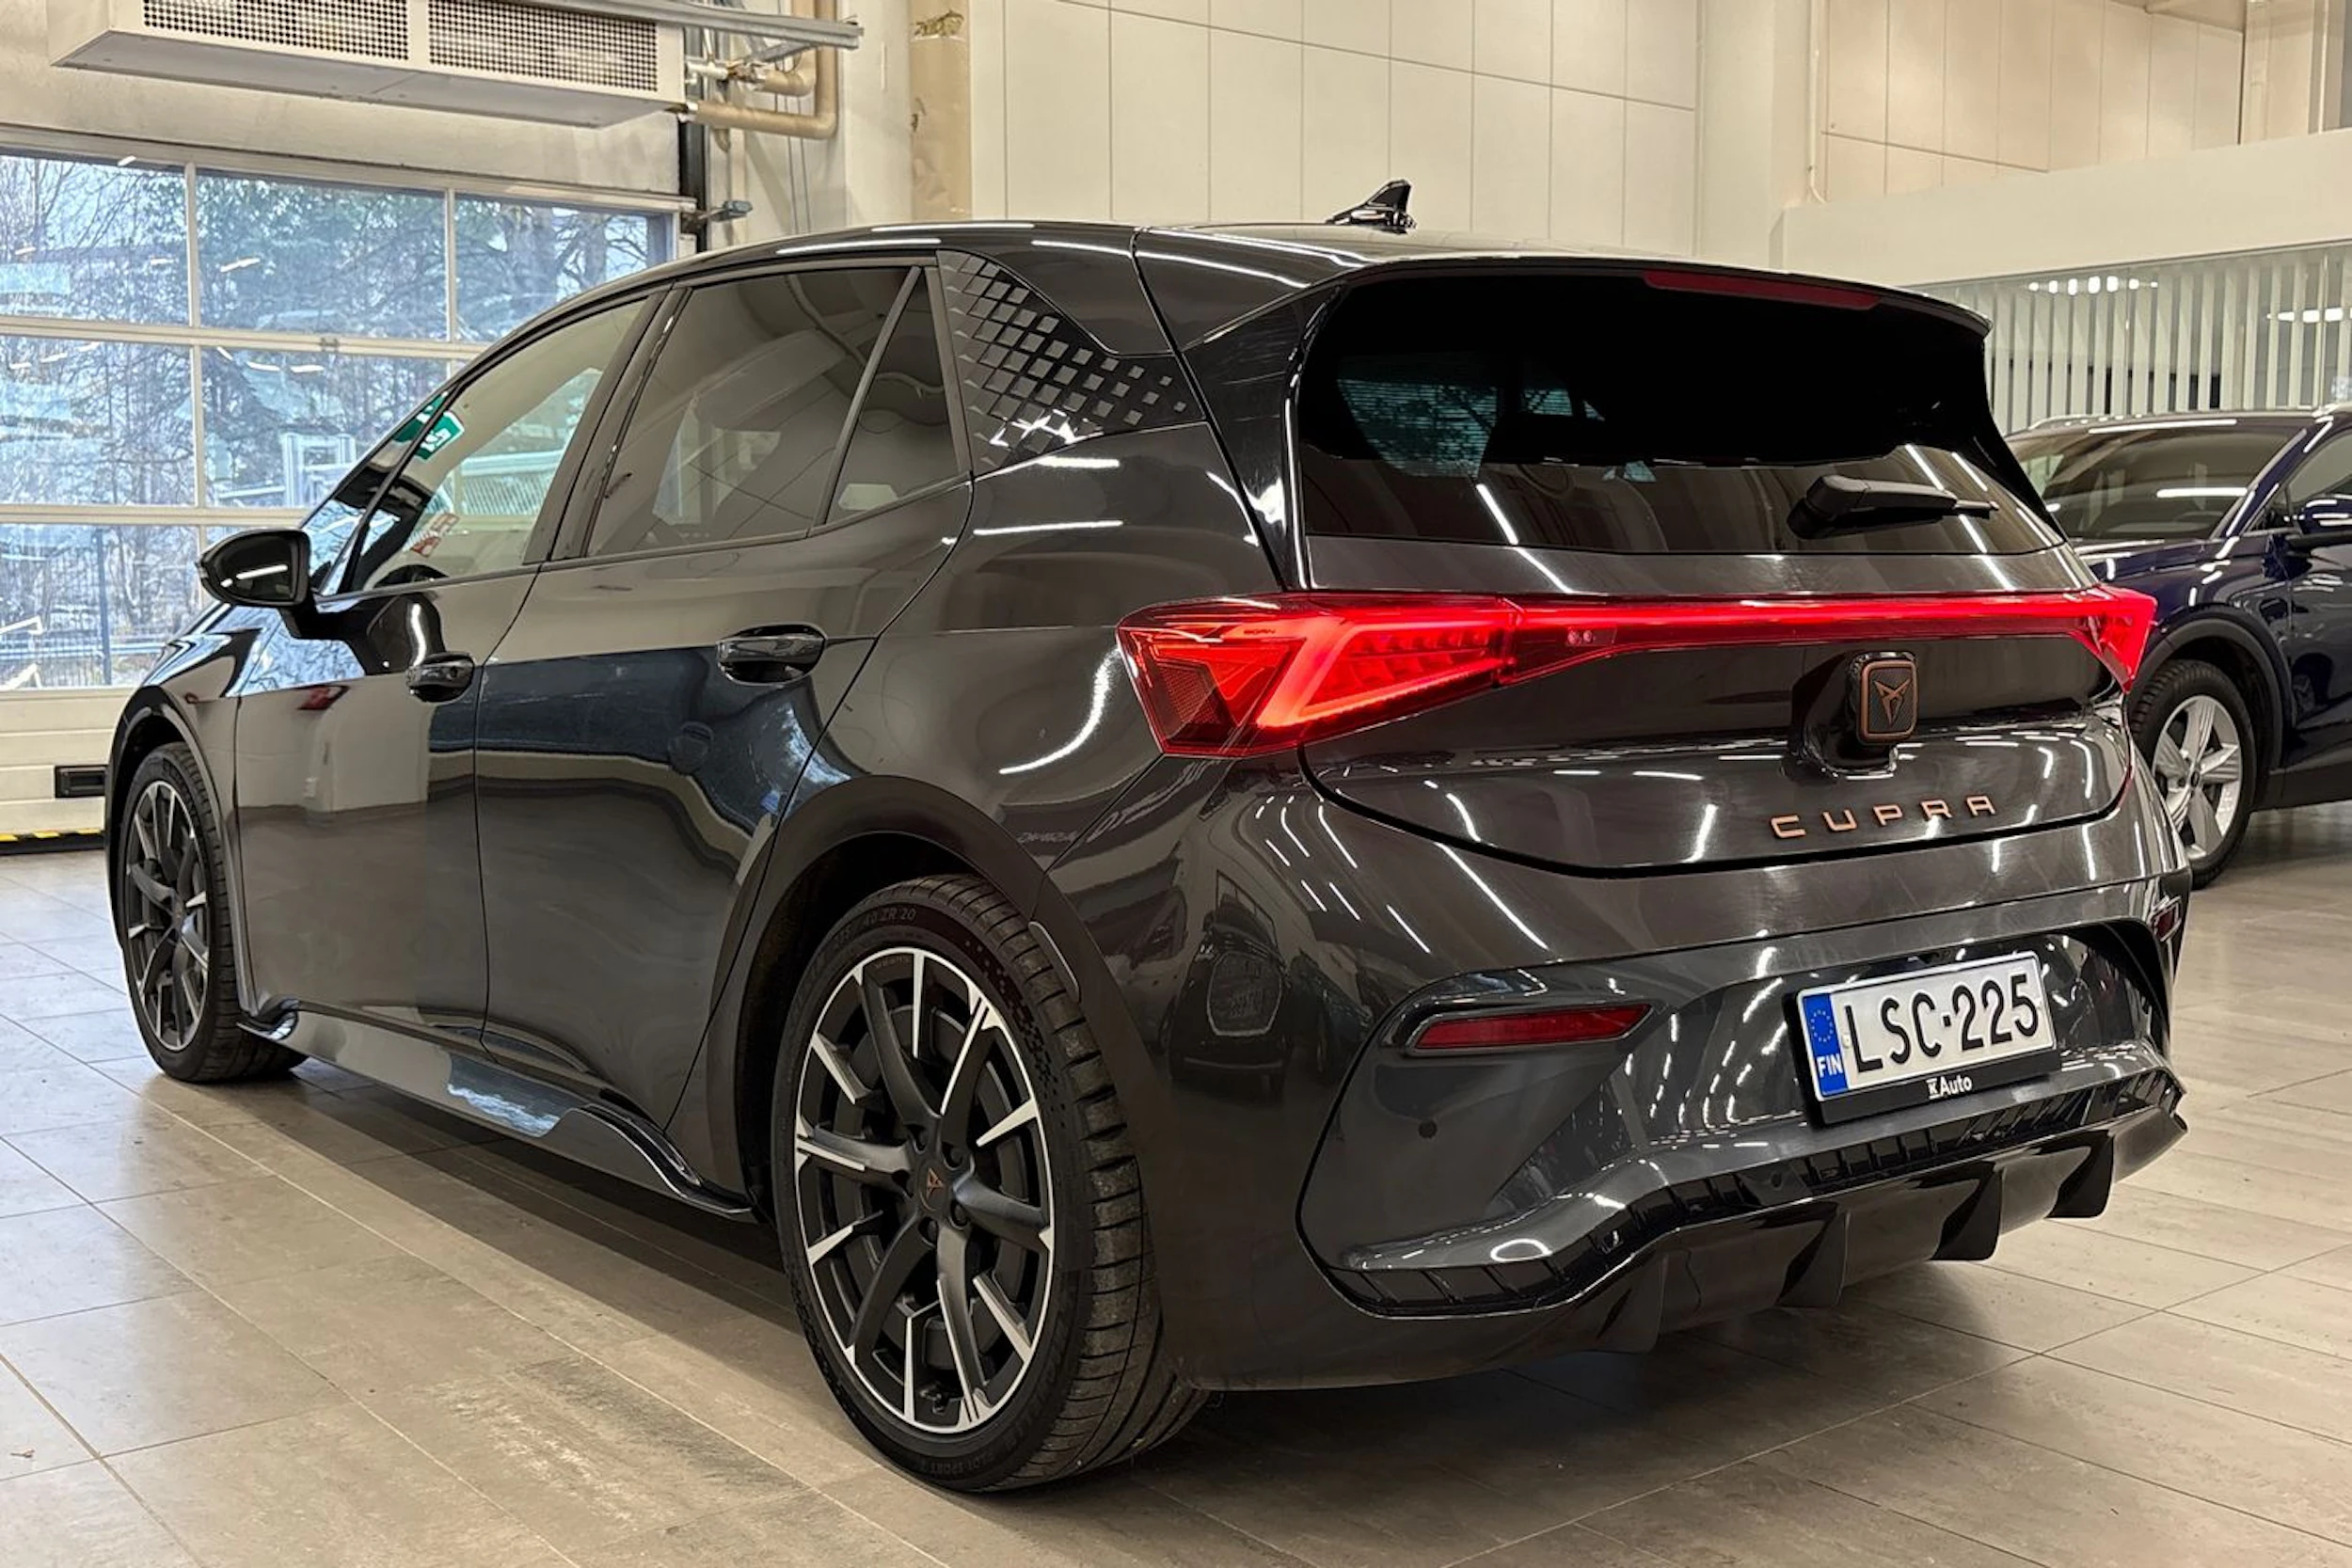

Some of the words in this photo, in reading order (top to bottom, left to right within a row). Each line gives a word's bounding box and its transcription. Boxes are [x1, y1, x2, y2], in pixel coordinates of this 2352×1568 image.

[1771, 795, 1995, 838] CUPRA
[898, 907, 916, 921] 20
[1817, 1053, 1844, 1079] FIN
